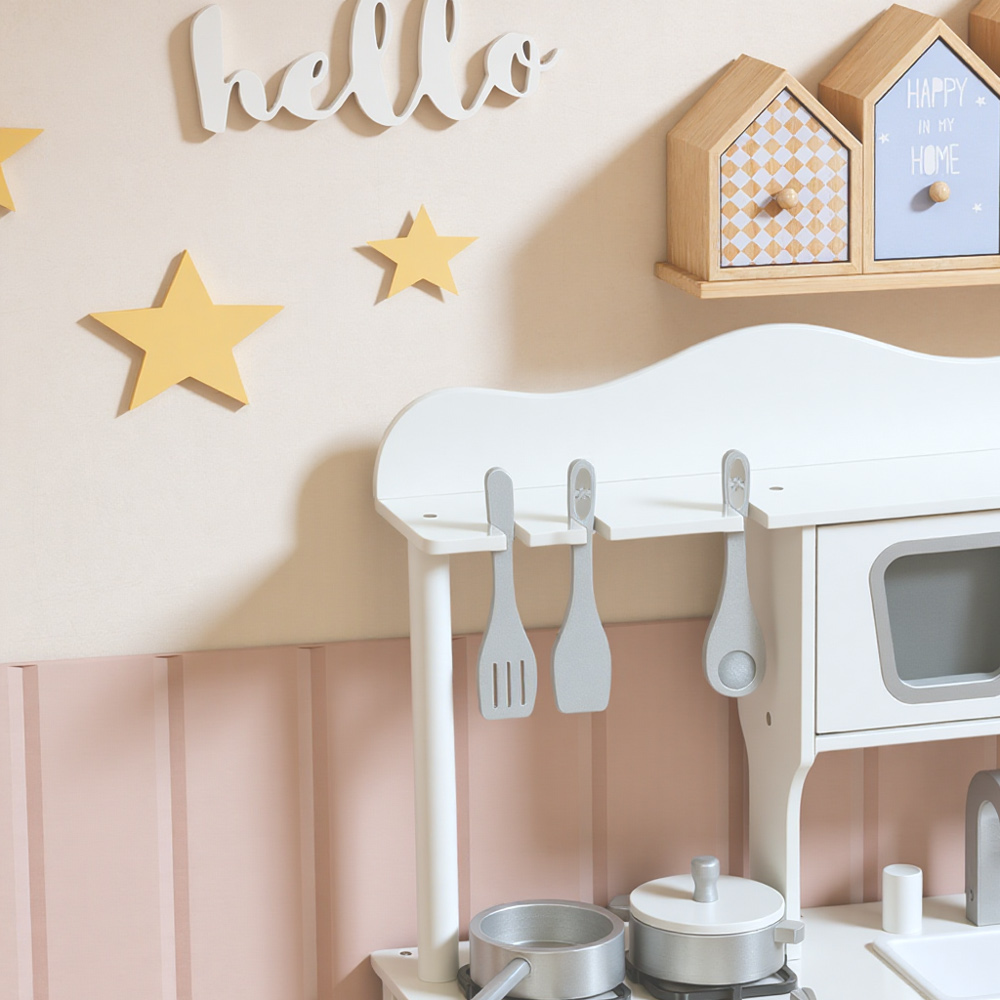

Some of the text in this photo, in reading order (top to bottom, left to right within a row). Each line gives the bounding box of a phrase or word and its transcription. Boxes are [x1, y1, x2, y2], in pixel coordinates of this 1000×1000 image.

[190, 0, 564, 133] hello
[907, 77, 968, 108] HAPPY
[918, 117, 955, 135] IN MY
[910, 143, 960, 176] HOME
